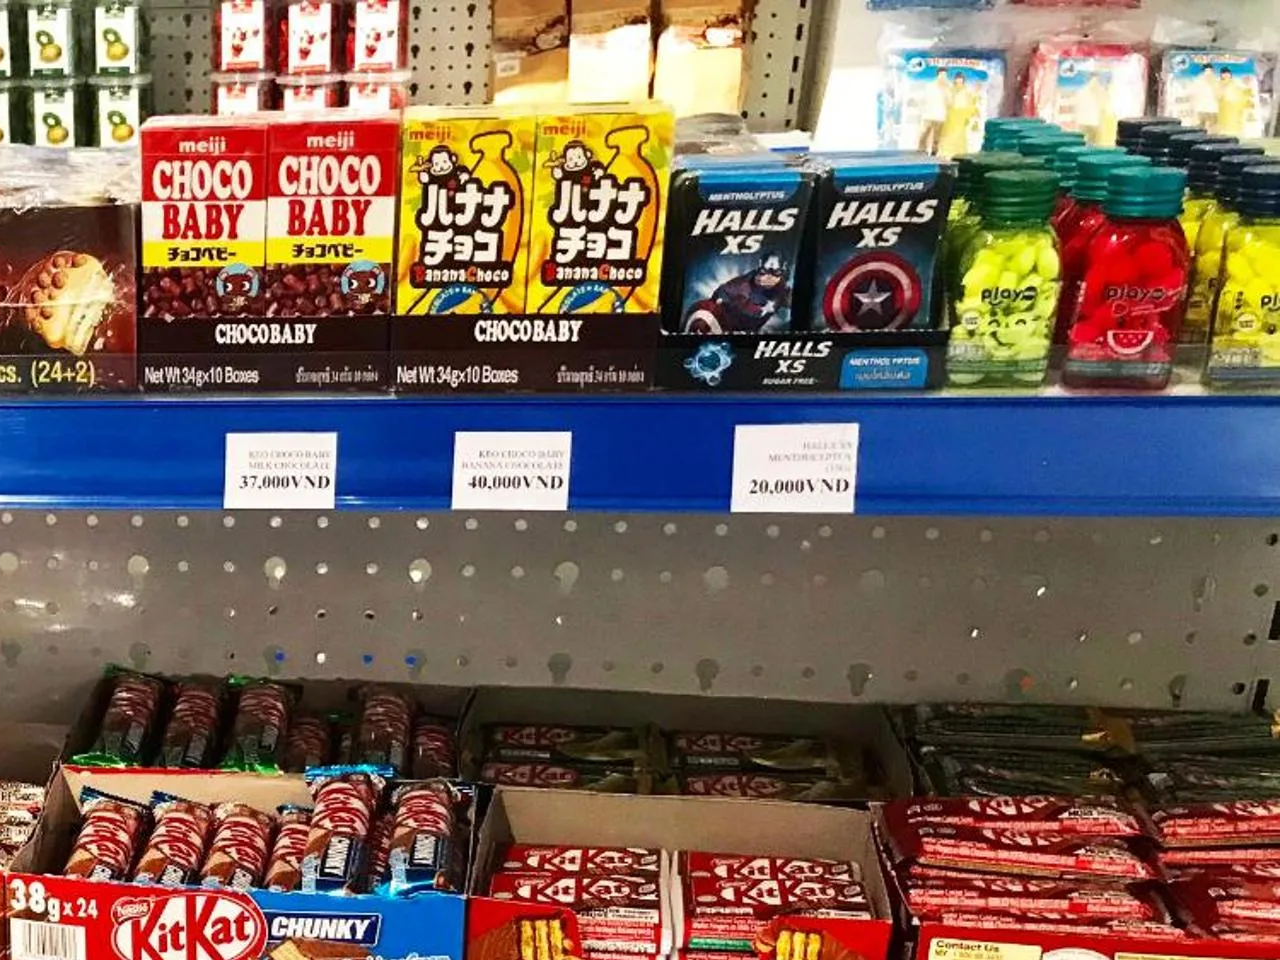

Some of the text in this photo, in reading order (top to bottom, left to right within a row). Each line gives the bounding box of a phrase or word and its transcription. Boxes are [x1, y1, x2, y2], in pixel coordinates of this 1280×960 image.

[409, 126, 451, 142] meiji
[543, 121, 586, 138] meiji
[179, 137, 227, 155] meiji
[306, 132, 355, 150] meiji
[152, 160, 253, 200] CHOCO
[278, 155, 382, 196] CHOCO
[162, 203, 244, 240] BABY
[287, 199, 372, 236] BABY
[691, 207, 799, 236] HALLS
[826, 199, 938, 230] HALLS
[424, 229, 501, 265] チョコ
[556, 226, 633, 262] チョコ
[720, 234, 764, 255] XS
[856, 227, 901, 248] XS
[754, 341, 833, 359] HALLS
[31, 360, 96, 385] (24+2)
[145, 368, 164, 383] Net
[165, 368, 180, 383] Wt
[224, 367, 260, 383] Boxes
[397, 367, 419, 383] Net
[420, 367, 435, 383] Wt
[482, 366, 518, 383] Boxes
[775, 360, 805, 373] XS
[239, 475, 330, 490] 37,000VND
[468, 475, 564, 489] 40,000VND
[749, 479, 849, 494] 20,000VND
[10, 880, 98, 922] 38g x 24
[270, 916, 371, 939] CHUNKY
[937, 941, 982, 952] Contact
